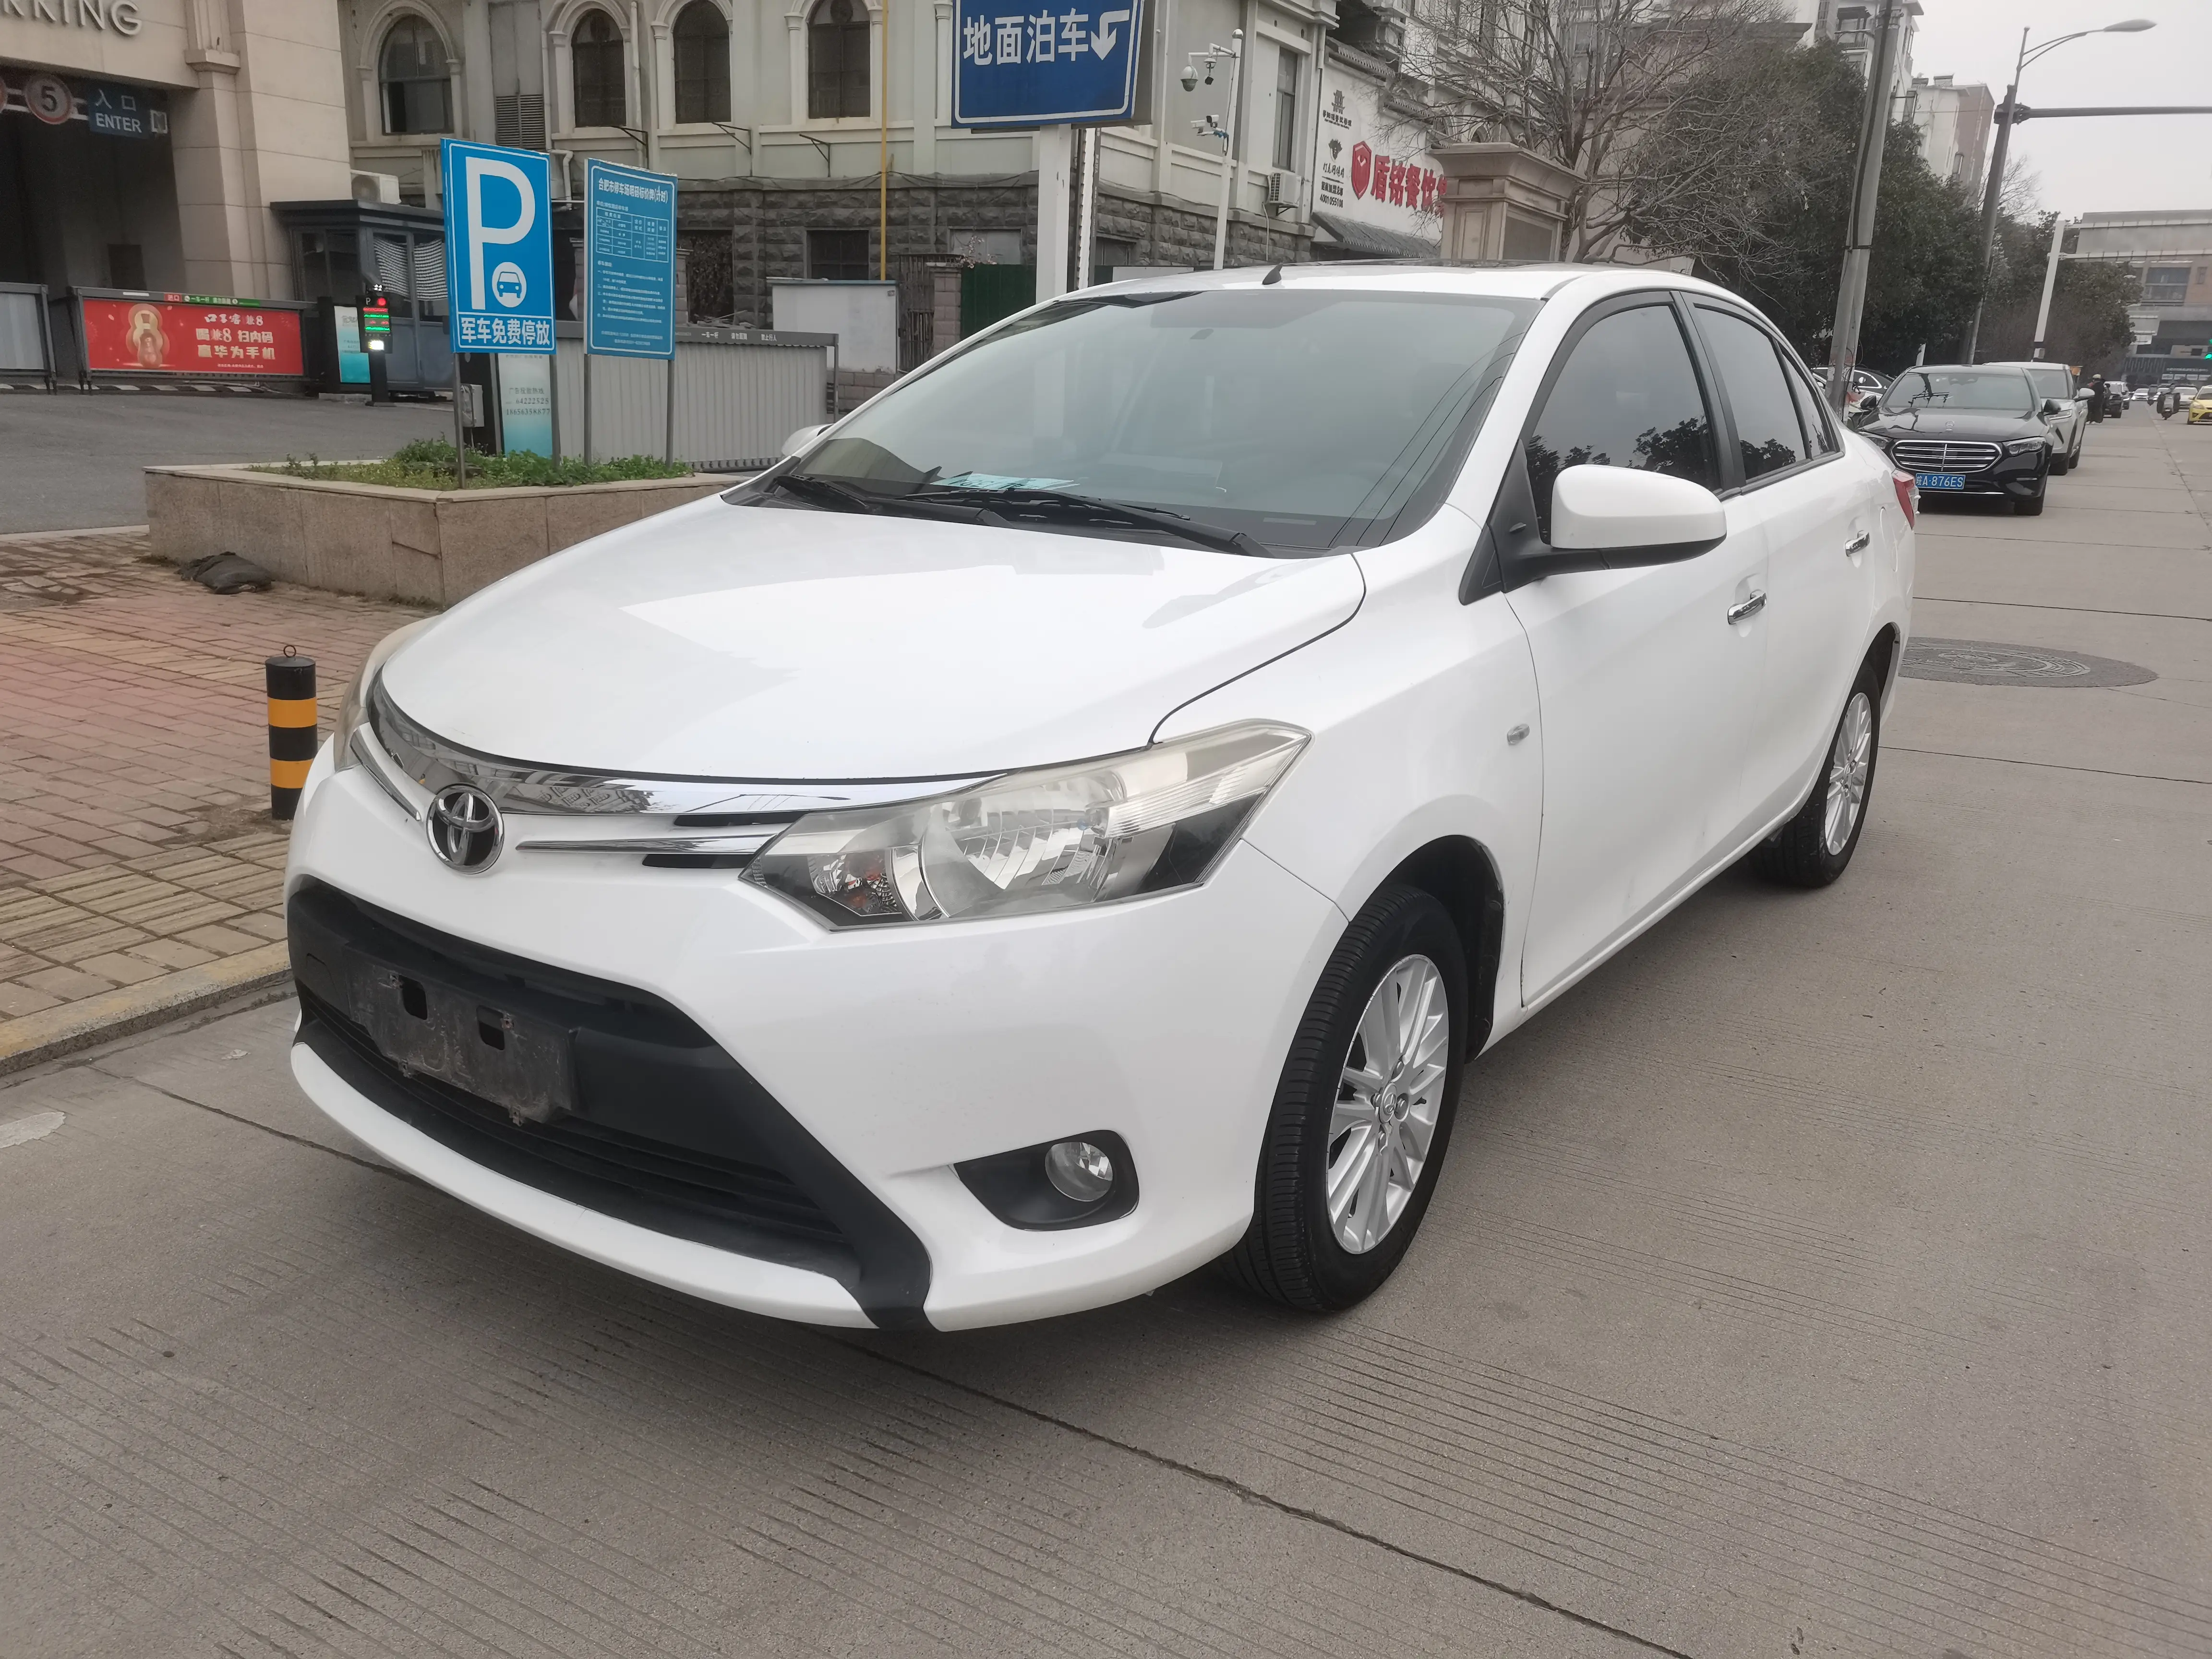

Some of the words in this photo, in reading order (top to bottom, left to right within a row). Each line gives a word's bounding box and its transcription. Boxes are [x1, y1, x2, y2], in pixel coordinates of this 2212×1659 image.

[963, 8, 1089, 65] 地面泊车
[41, 85, 58, 112] 5
[96, 88, 137, 111] 入口
[96, 112, 142, 133] ENTER
[465, 156, 536, 310] P
[461, 317, 550, 346] 军车免费停放
